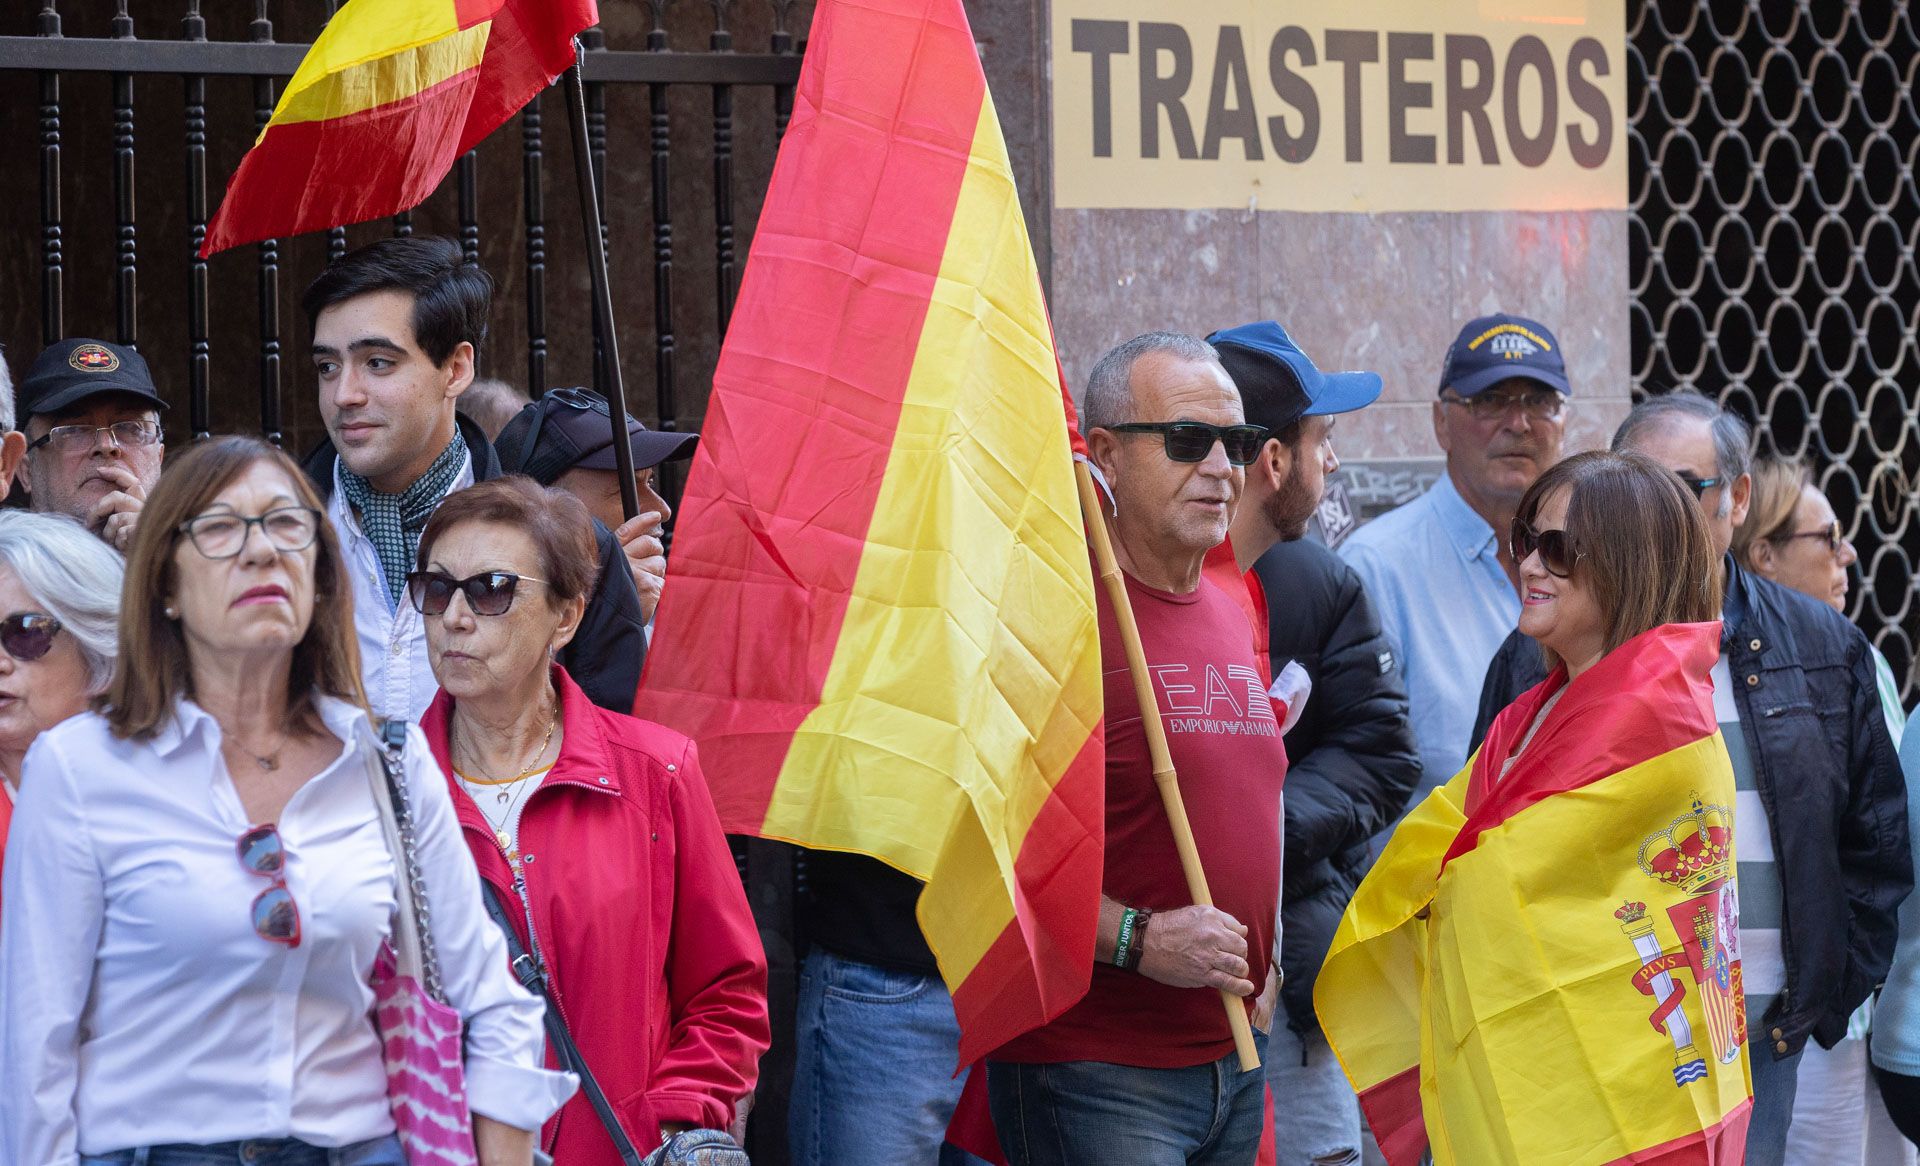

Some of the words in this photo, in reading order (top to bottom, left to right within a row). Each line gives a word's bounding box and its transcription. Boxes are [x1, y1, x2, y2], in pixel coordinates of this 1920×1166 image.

[1071, 18, 1613, 168] TRASTEROS
[1170, 718, 1225, 734] EMPORIO
[1121, 914, 1134, 944] JUNTOS
[1640, 956, 1676, 980] PLVS
